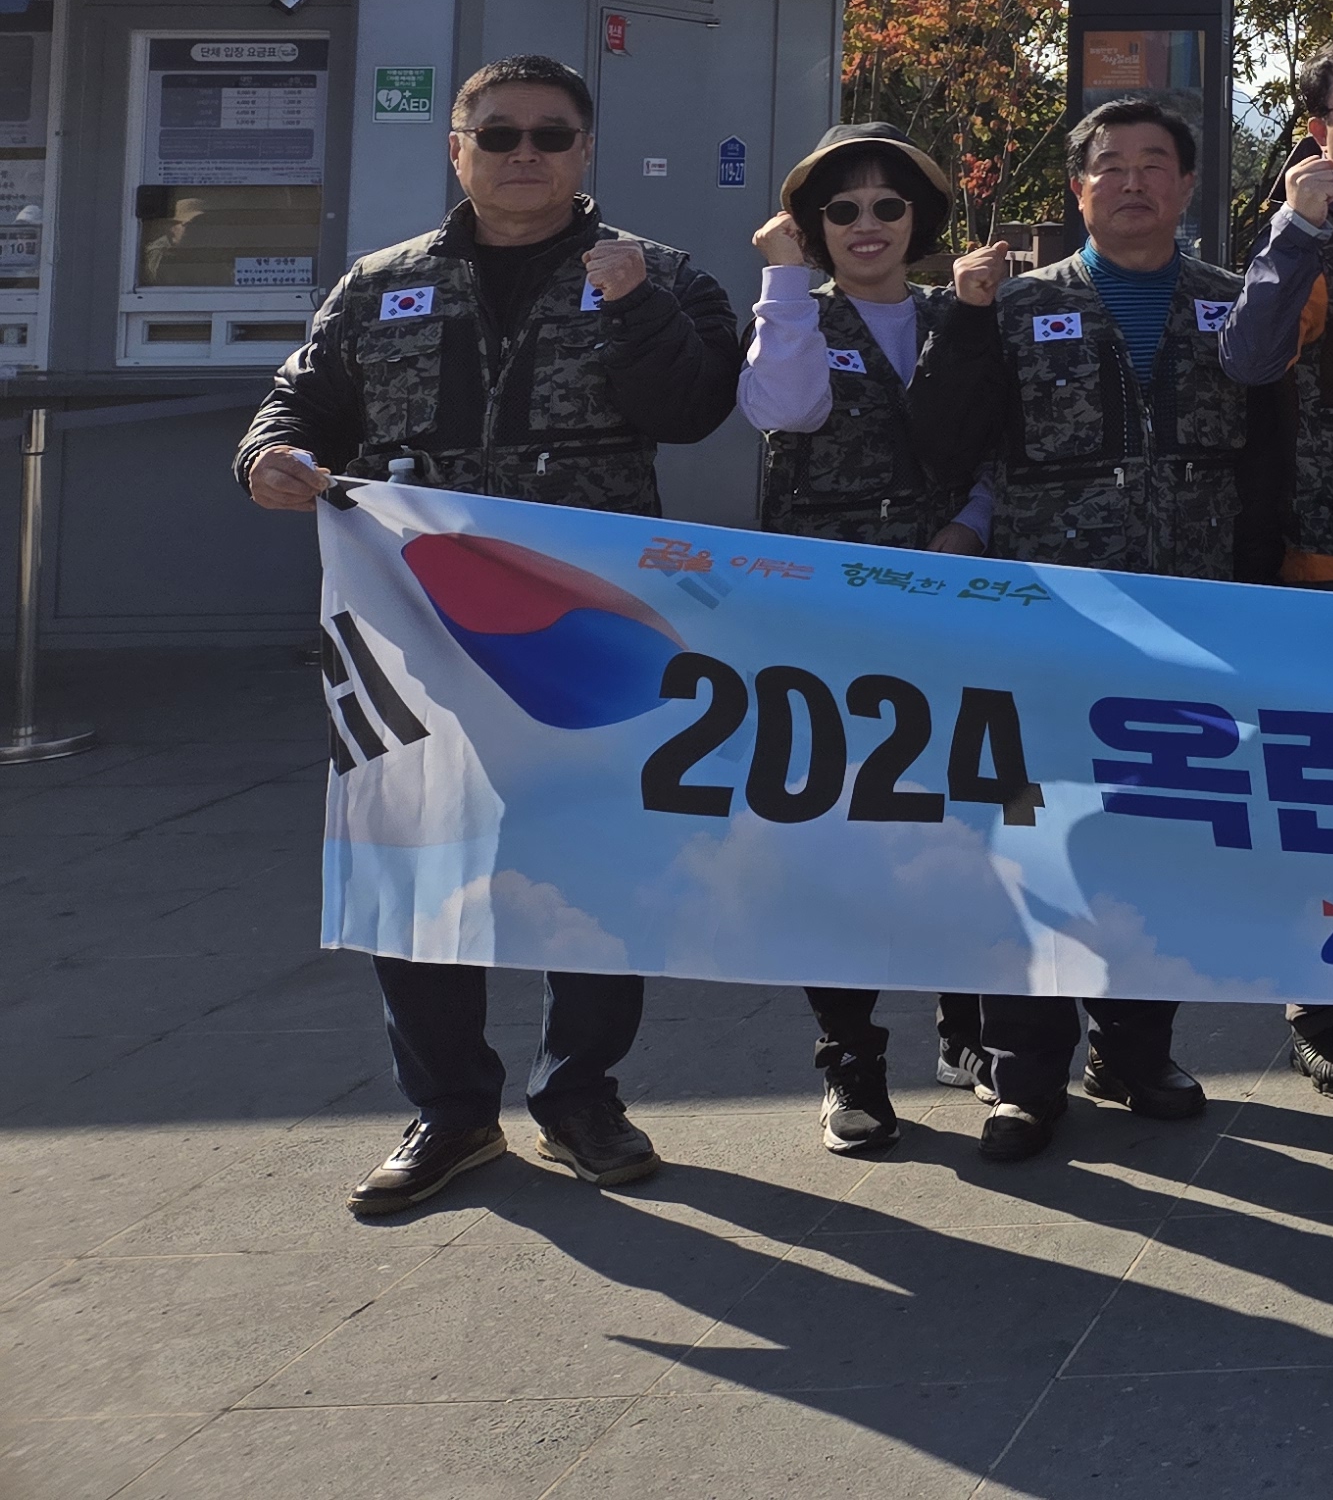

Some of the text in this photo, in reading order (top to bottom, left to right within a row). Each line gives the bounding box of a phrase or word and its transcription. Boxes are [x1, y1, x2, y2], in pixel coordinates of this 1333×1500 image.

[200, 46, 277, 59] 단체 입장 요금표
[398, 98, 430, 111] AED
[720, 162, 744, 182] 119-27
[638, 536, 1052, 607] 꿈을 이루는 행복한 연수
[641, 651, 1046, 827] 2024
